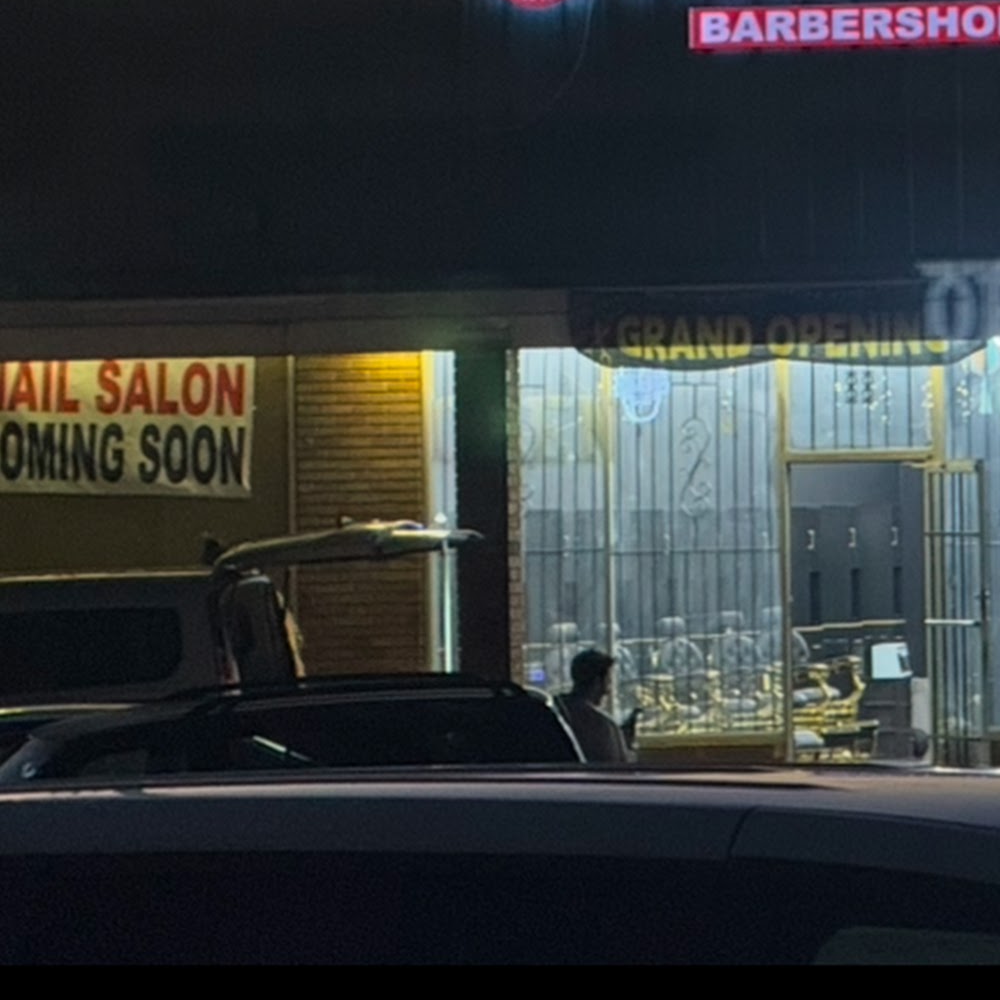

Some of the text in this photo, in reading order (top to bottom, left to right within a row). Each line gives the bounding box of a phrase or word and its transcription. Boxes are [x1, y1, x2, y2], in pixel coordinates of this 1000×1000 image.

[616, 315, 751, 361] GRAND
[0, 360, 246, 416] AIL SALON
[138, 423, 246, 485] SOON
